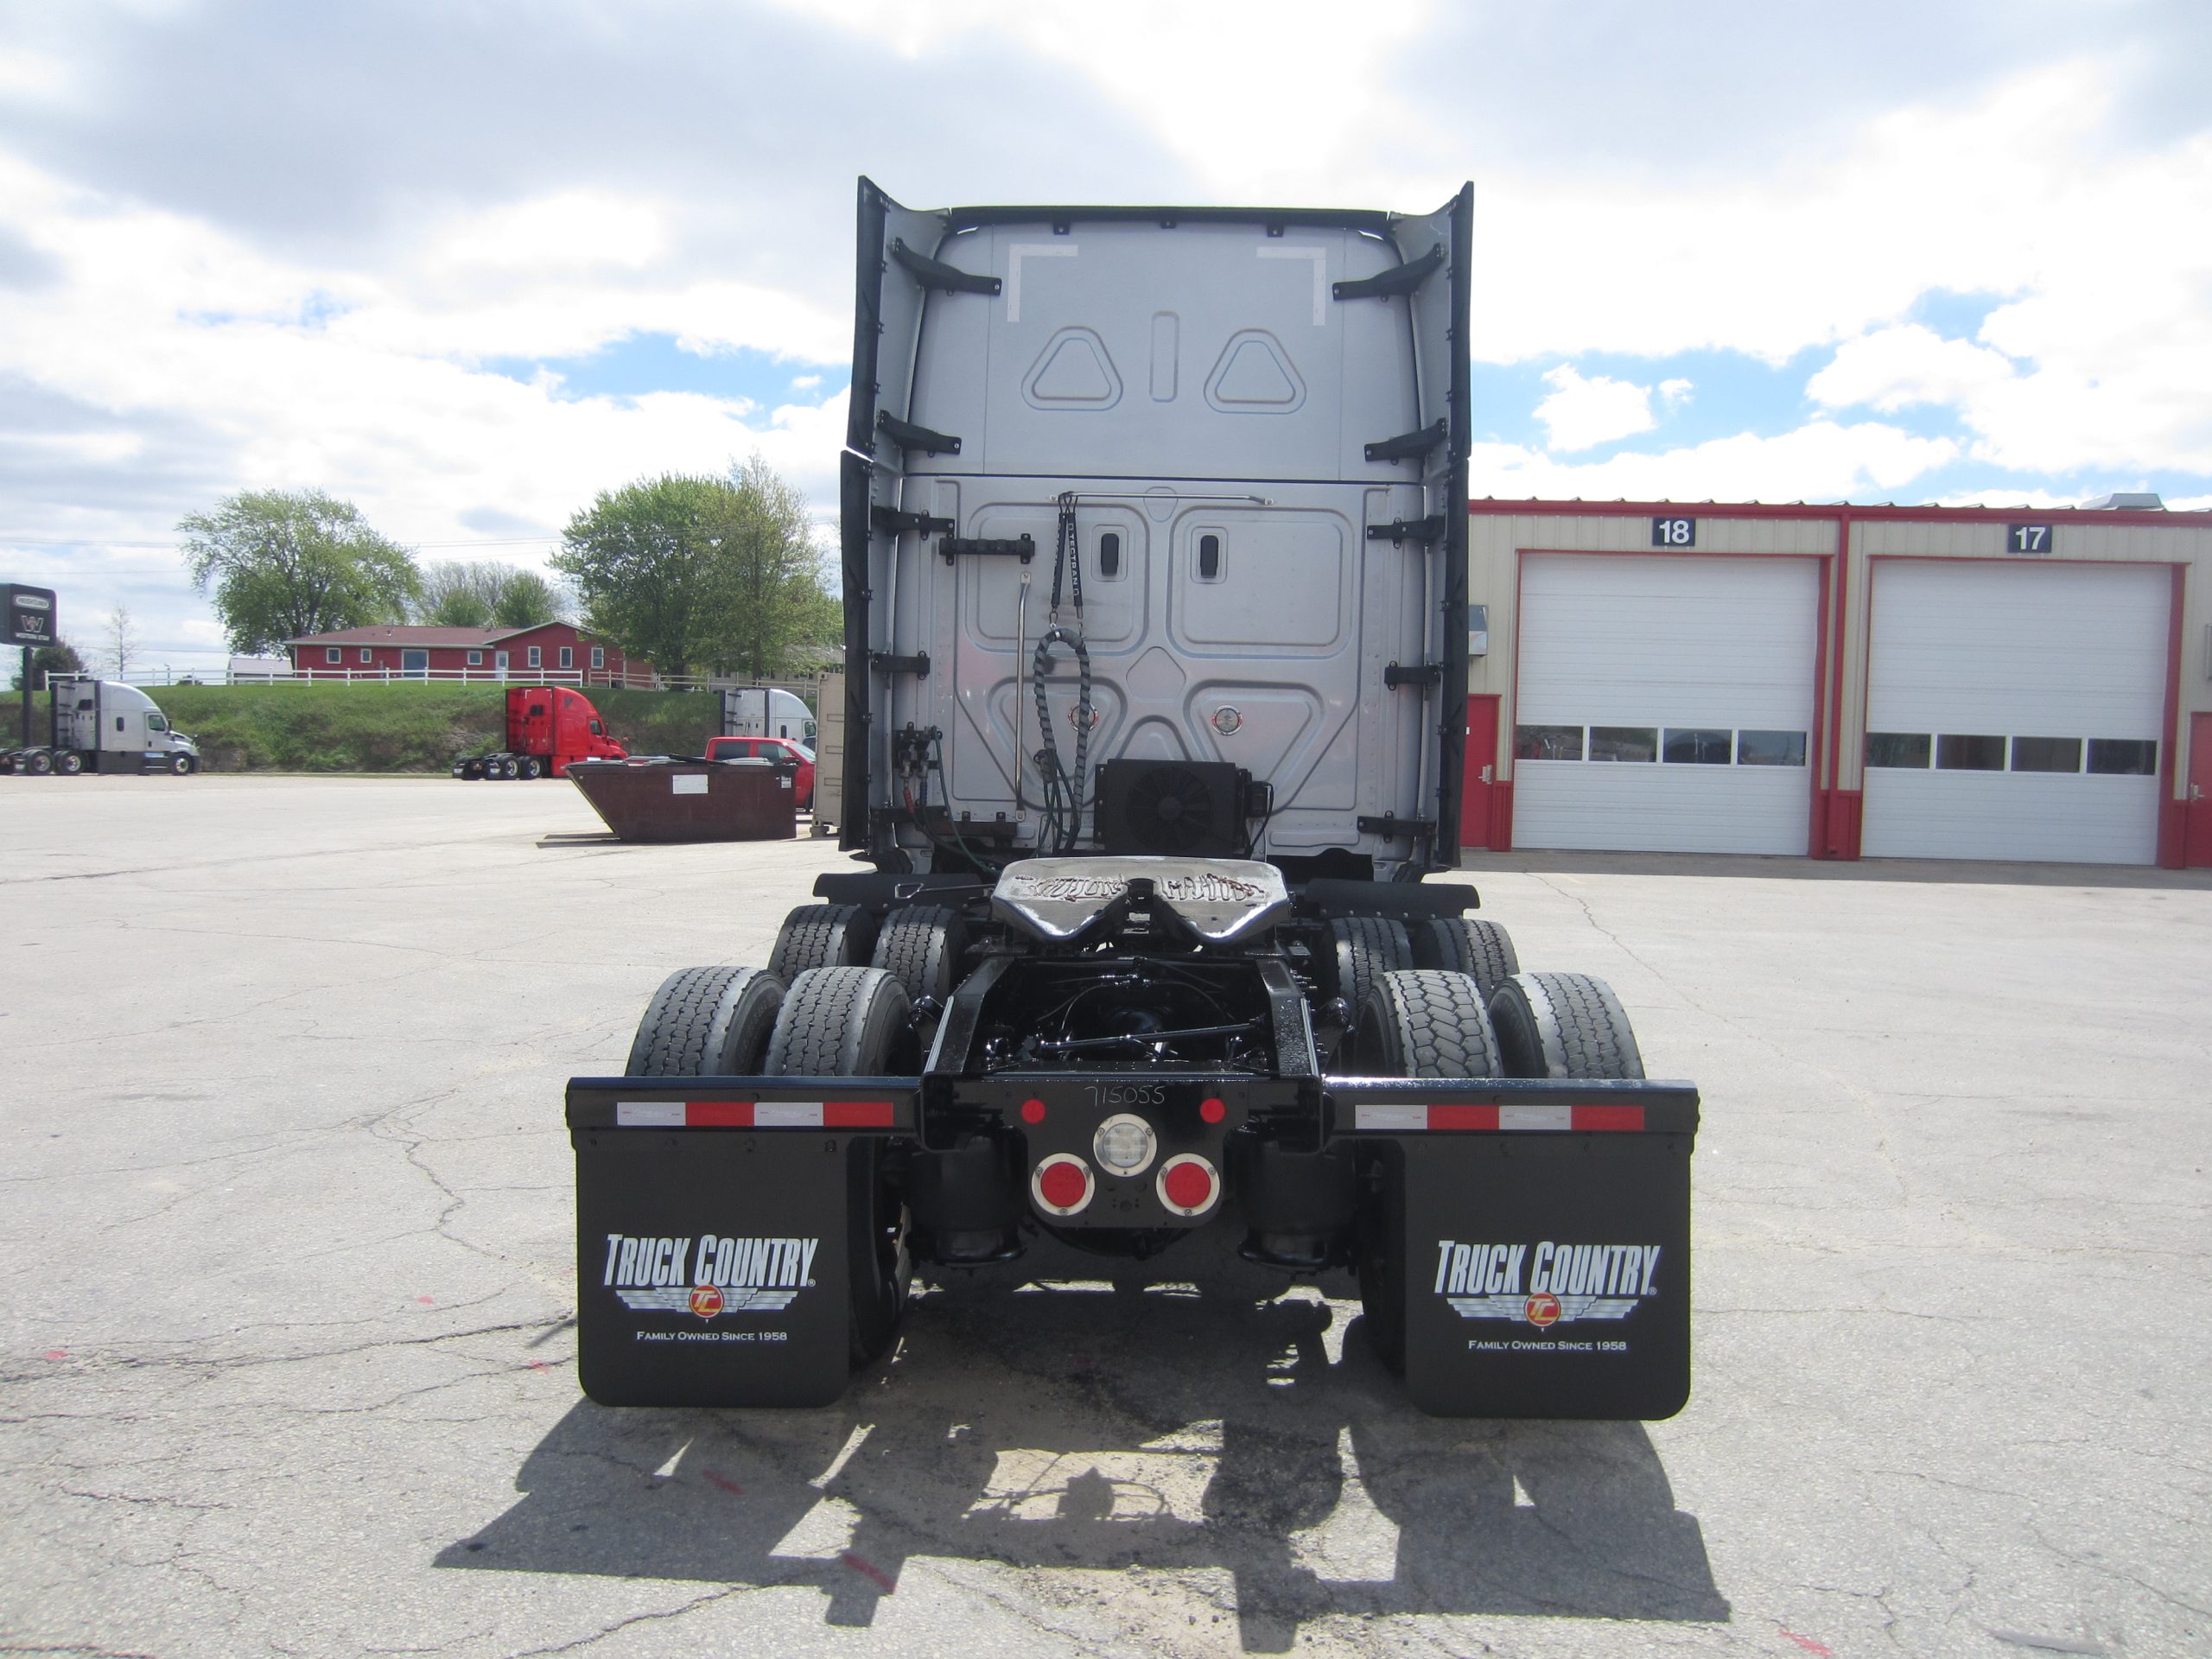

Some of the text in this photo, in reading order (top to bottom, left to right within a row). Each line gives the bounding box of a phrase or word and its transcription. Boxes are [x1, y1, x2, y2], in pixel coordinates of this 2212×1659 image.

[1659, 520, 1689, 543] 18
[2015, 527, 2046, 550] 17
[1069, 534, 1078, 585] TECTRAN
[1084, 1085, 1166, 1106] 715055
[604, 1234, 819, 1287] TRUCK COUNTRY
[1434, 1240, 1661, 1295] TRUCK COUNTRY
[636, 1331, 788, 1341] FAMILY OWNED SINCE 1958
[1468, 1340, 1627, 1351] FAMILY OWNED SINCE 1958
